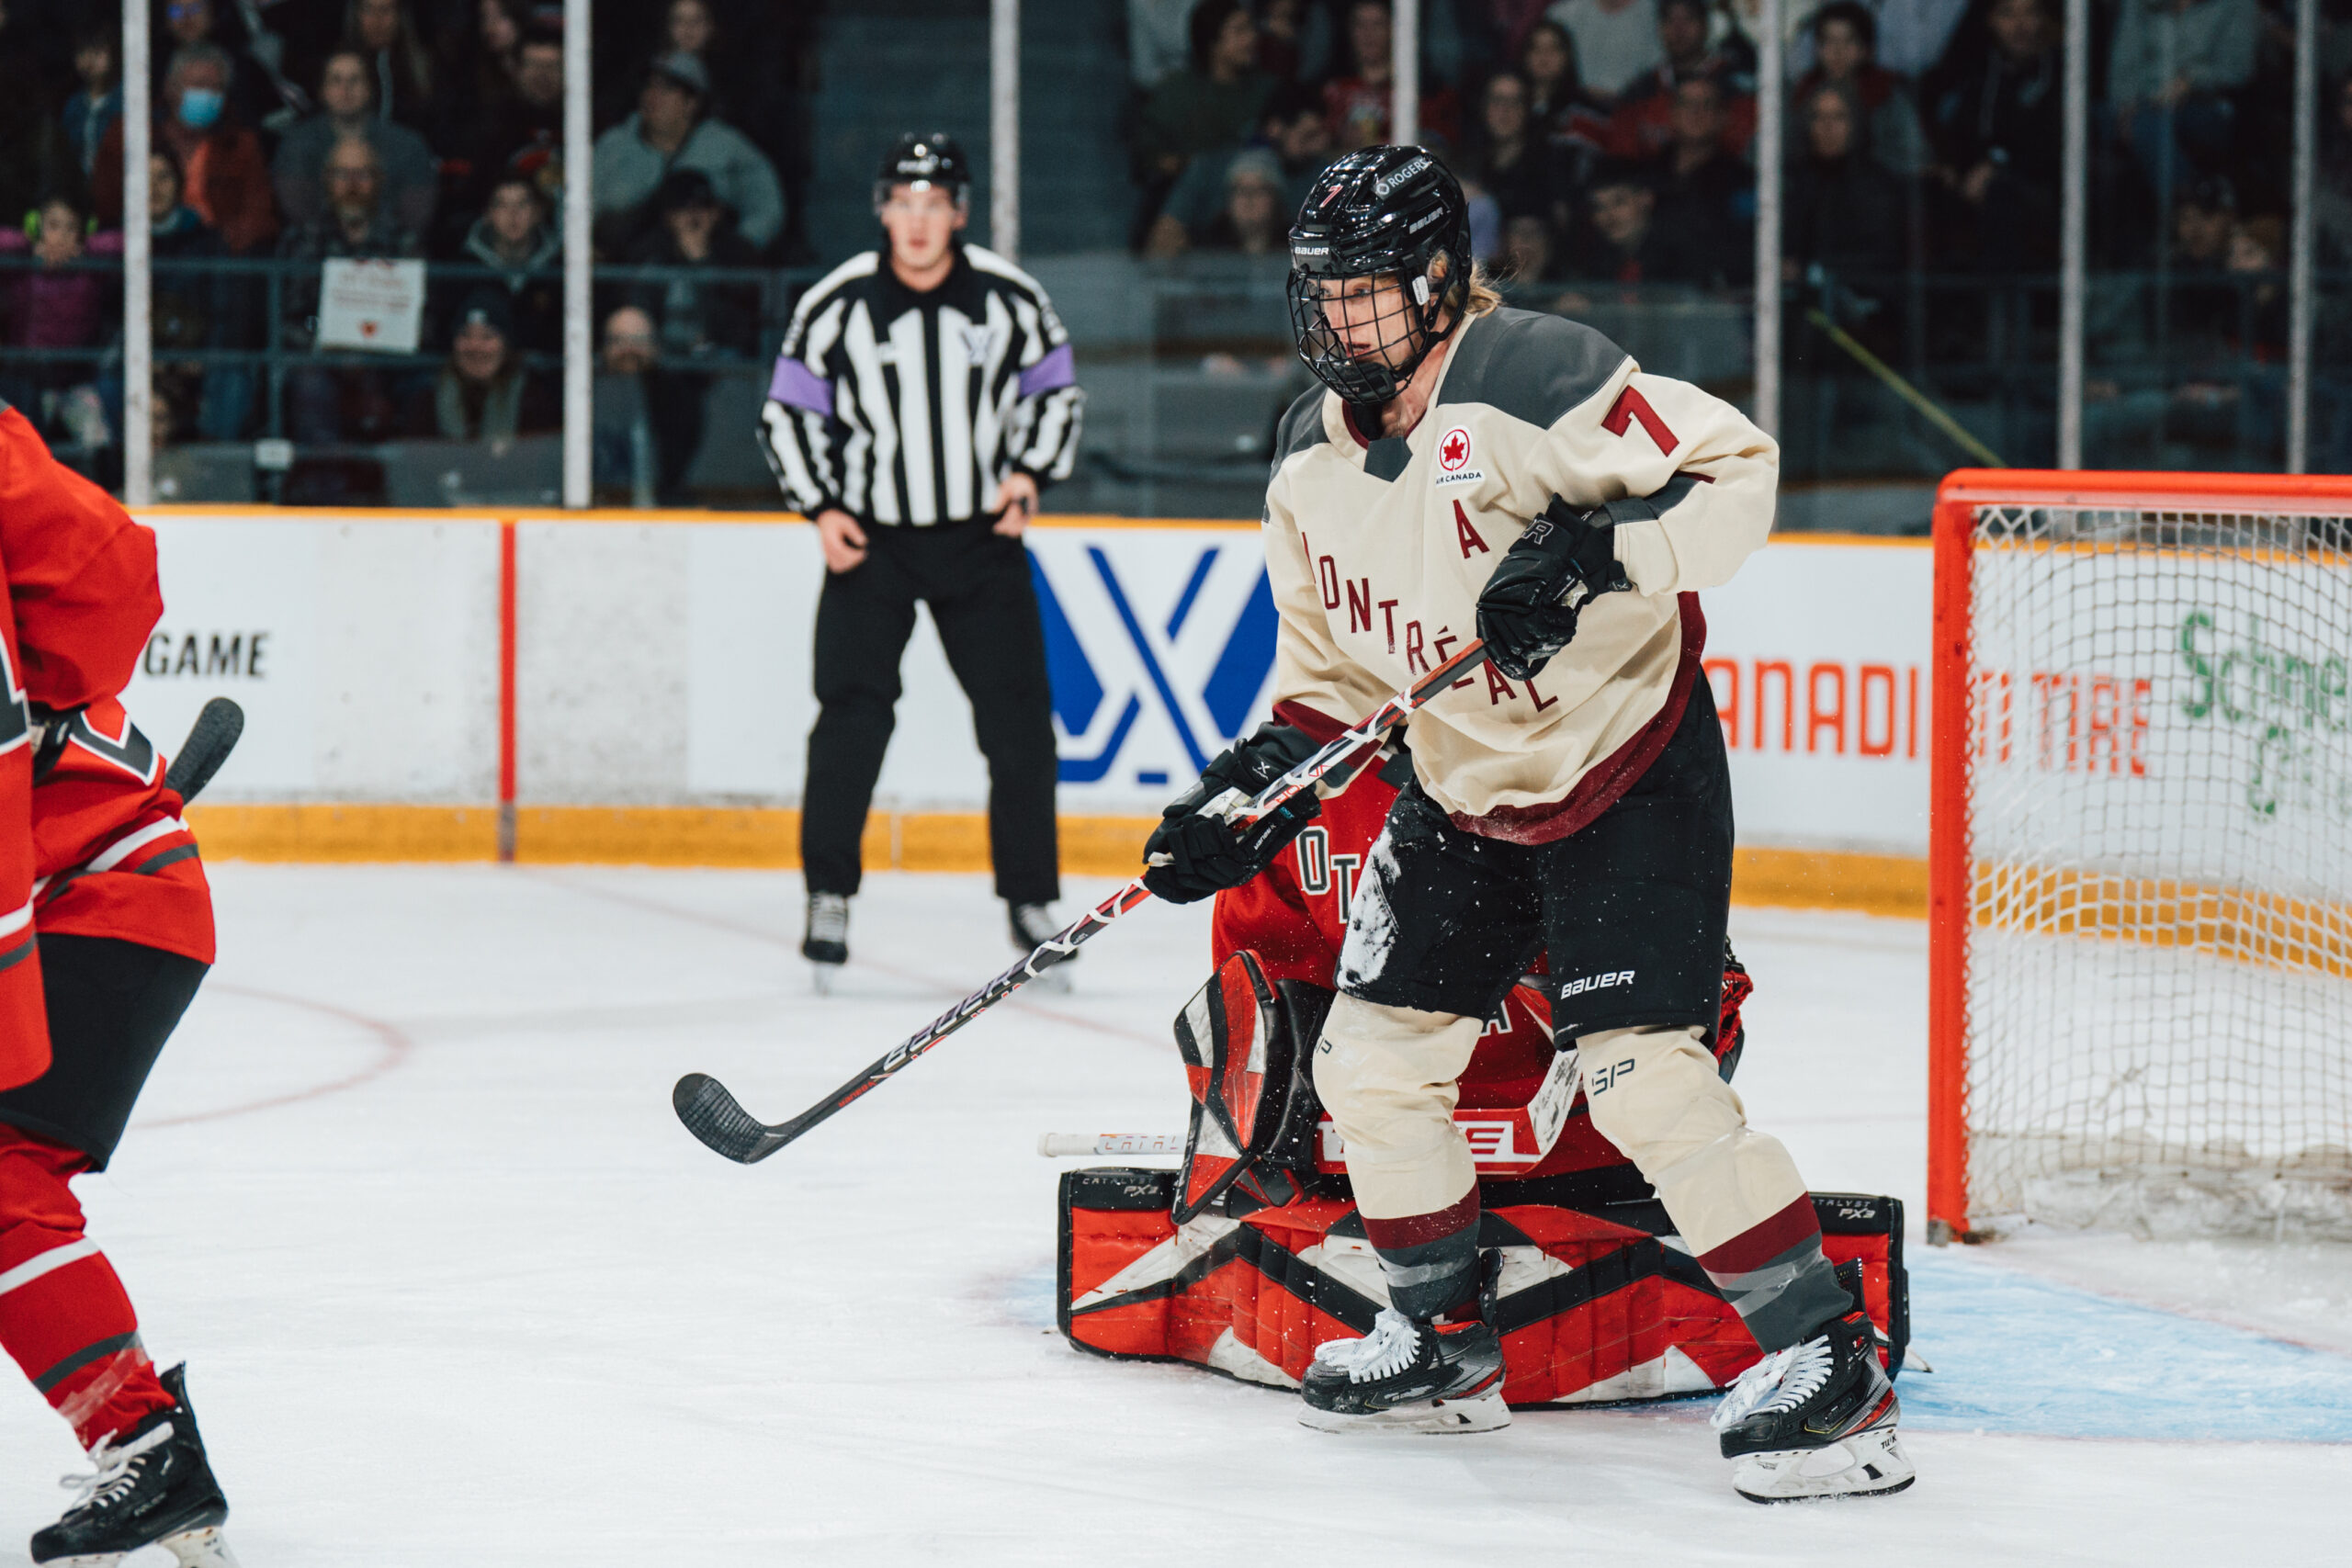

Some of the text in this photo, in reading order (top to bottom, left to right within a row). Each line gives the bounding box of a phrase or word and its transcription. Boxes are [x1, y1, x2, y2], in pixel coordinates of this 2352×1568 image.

[1388, 157, 1429, 188] ROGERS
[1319, 184, 1344, 209] 7
[1294, 246, 1329, 255] BAUER
[1601, 386, 1679, 457] 7
[1445, 472, 1482, 482] CANADA
[1453, 499, 1490, 559] A
[1301, 531, 1559, 713] ONTRÉAL
[144, 631, 268, 677] GAME
[2178, 613, 2352, 732] Schne
[1702, 657, 2012, 764] ANADIN
[1295, 825, 1361, 924] OT
[1561, 970, 1635, 1000] BAUER
[1812, 1199, 1871, 1208] TALYST
